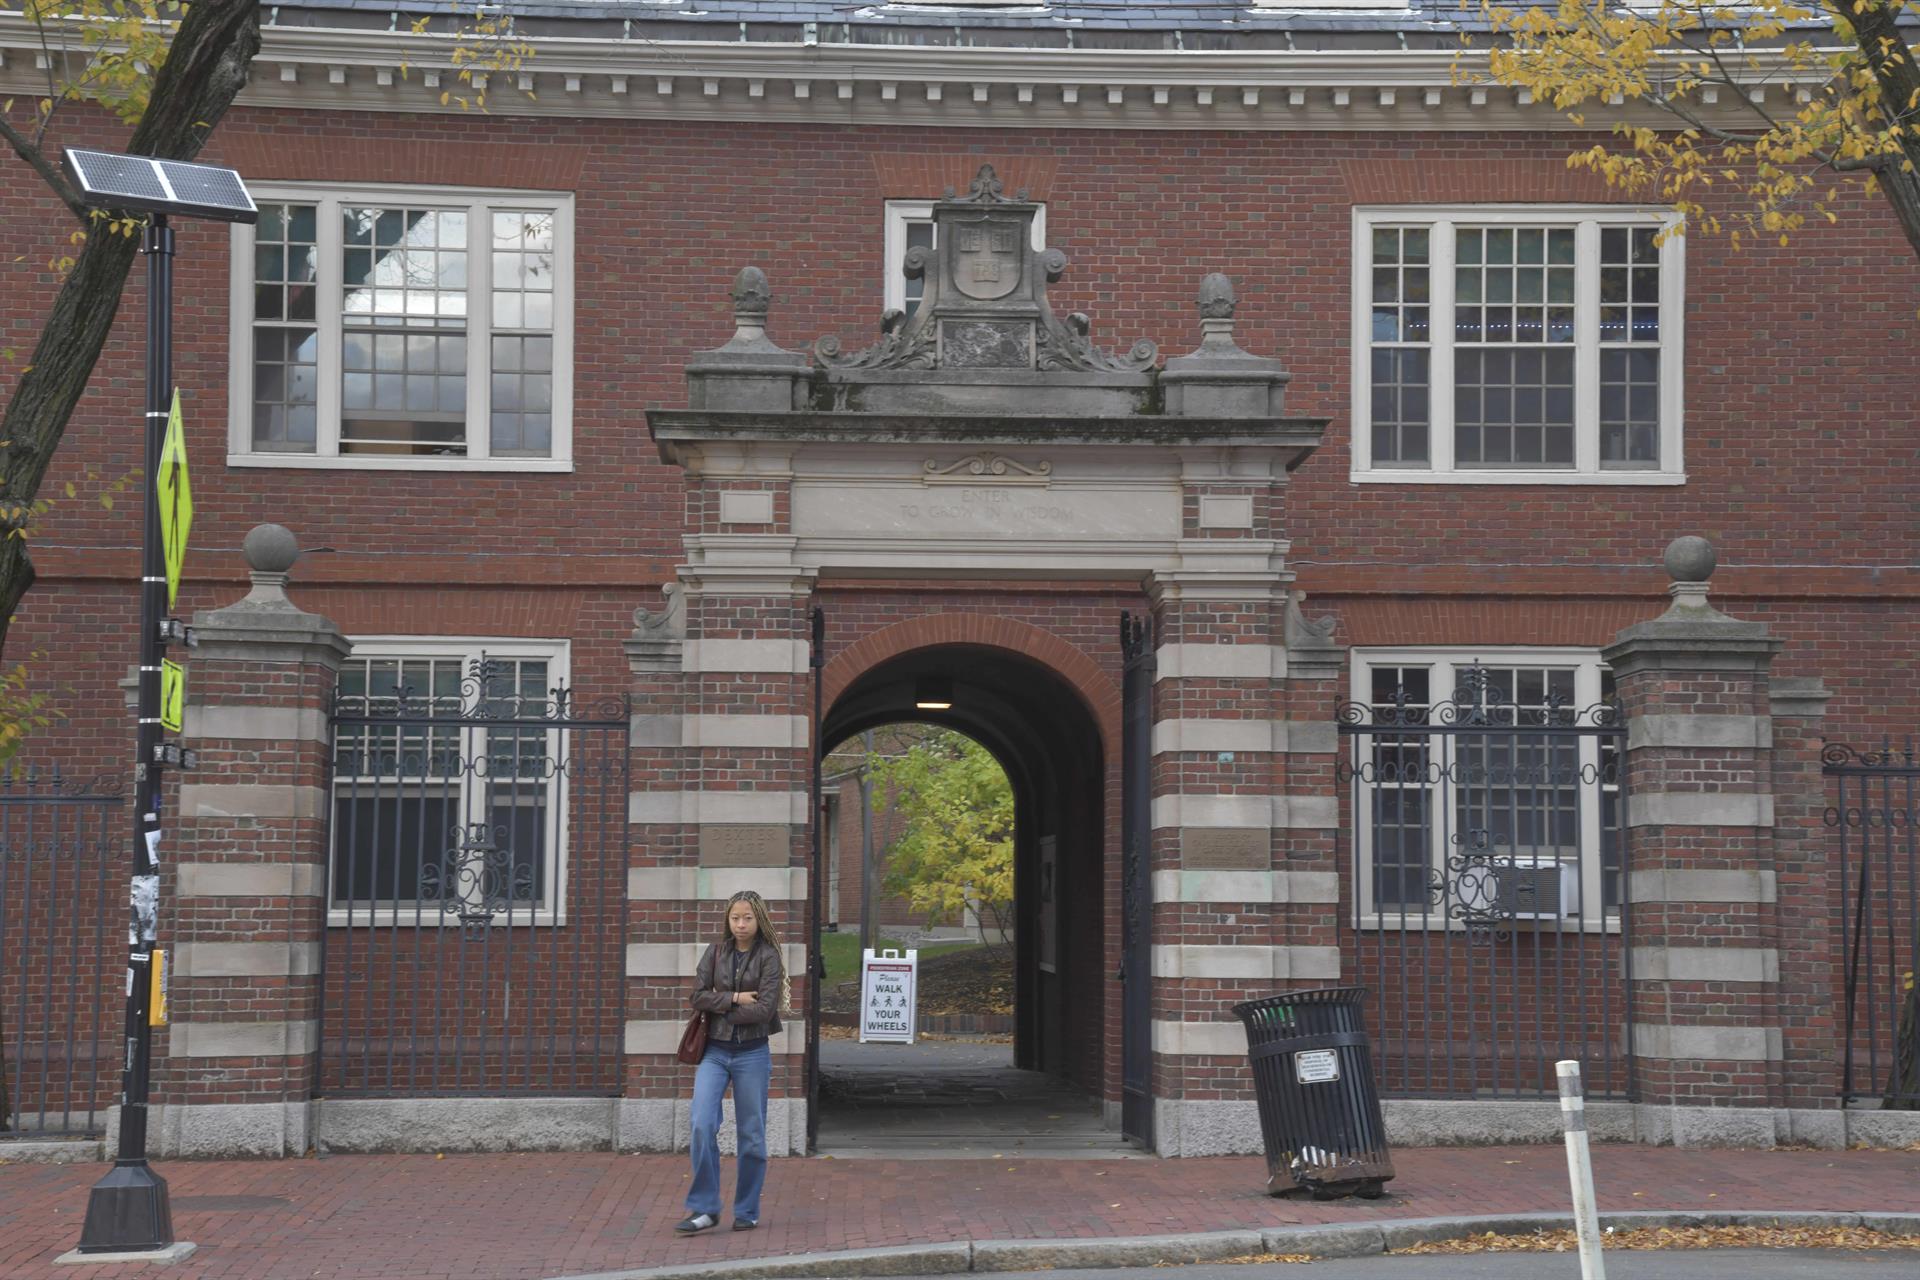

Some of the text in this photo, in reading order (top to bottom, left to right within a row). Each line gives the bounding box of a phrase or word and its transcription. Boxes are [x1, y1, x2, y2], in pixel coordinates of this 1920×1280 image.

[961, 489, 1011, 503] ENTER
[898, 504, 1074, 520] TO GROW IN WISDOM
[711, 828, 777, 841] DEXTER
[724, 842, 767, 856] GATE
[875, 984, 903, 993] WALK
[874, 1009, 901, 1019] YOUR
[867, 1021, 907, 1031] WHEELS
